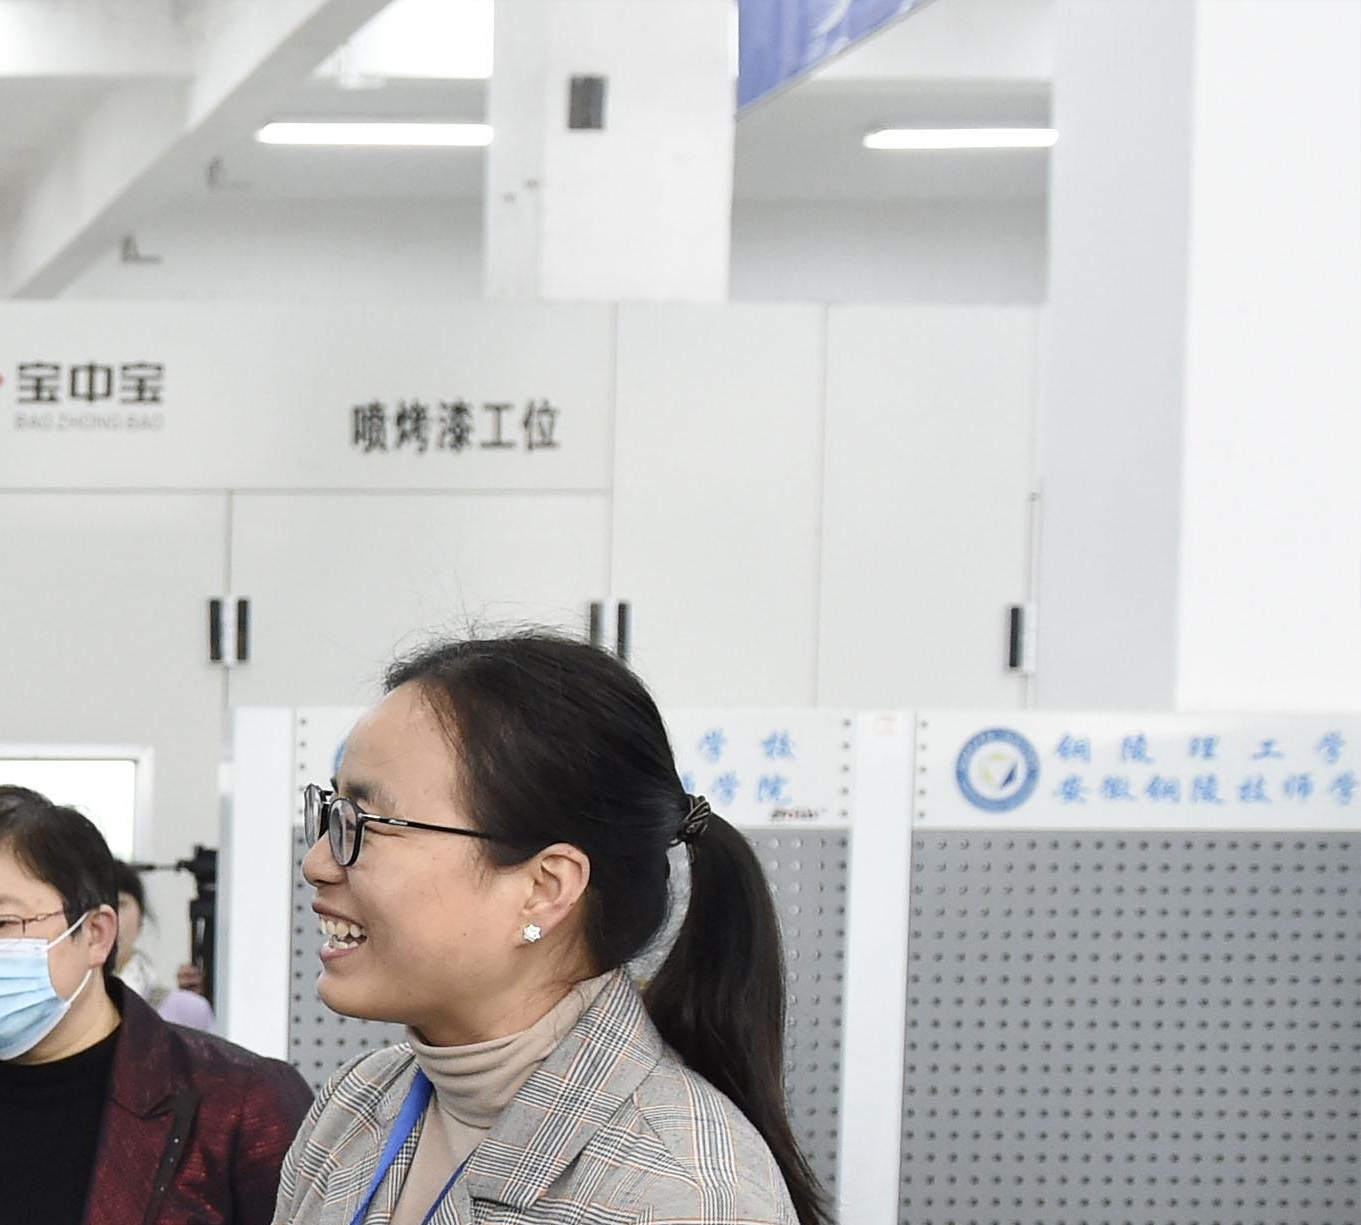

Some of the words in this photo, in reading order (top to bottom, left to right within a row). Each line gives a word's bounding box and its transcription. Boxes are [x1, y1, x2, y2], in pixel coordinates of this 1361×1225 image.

[16, 360, 166, 405] 宝中宝
[351, 398, 561, 455] 喷烤漆工位
